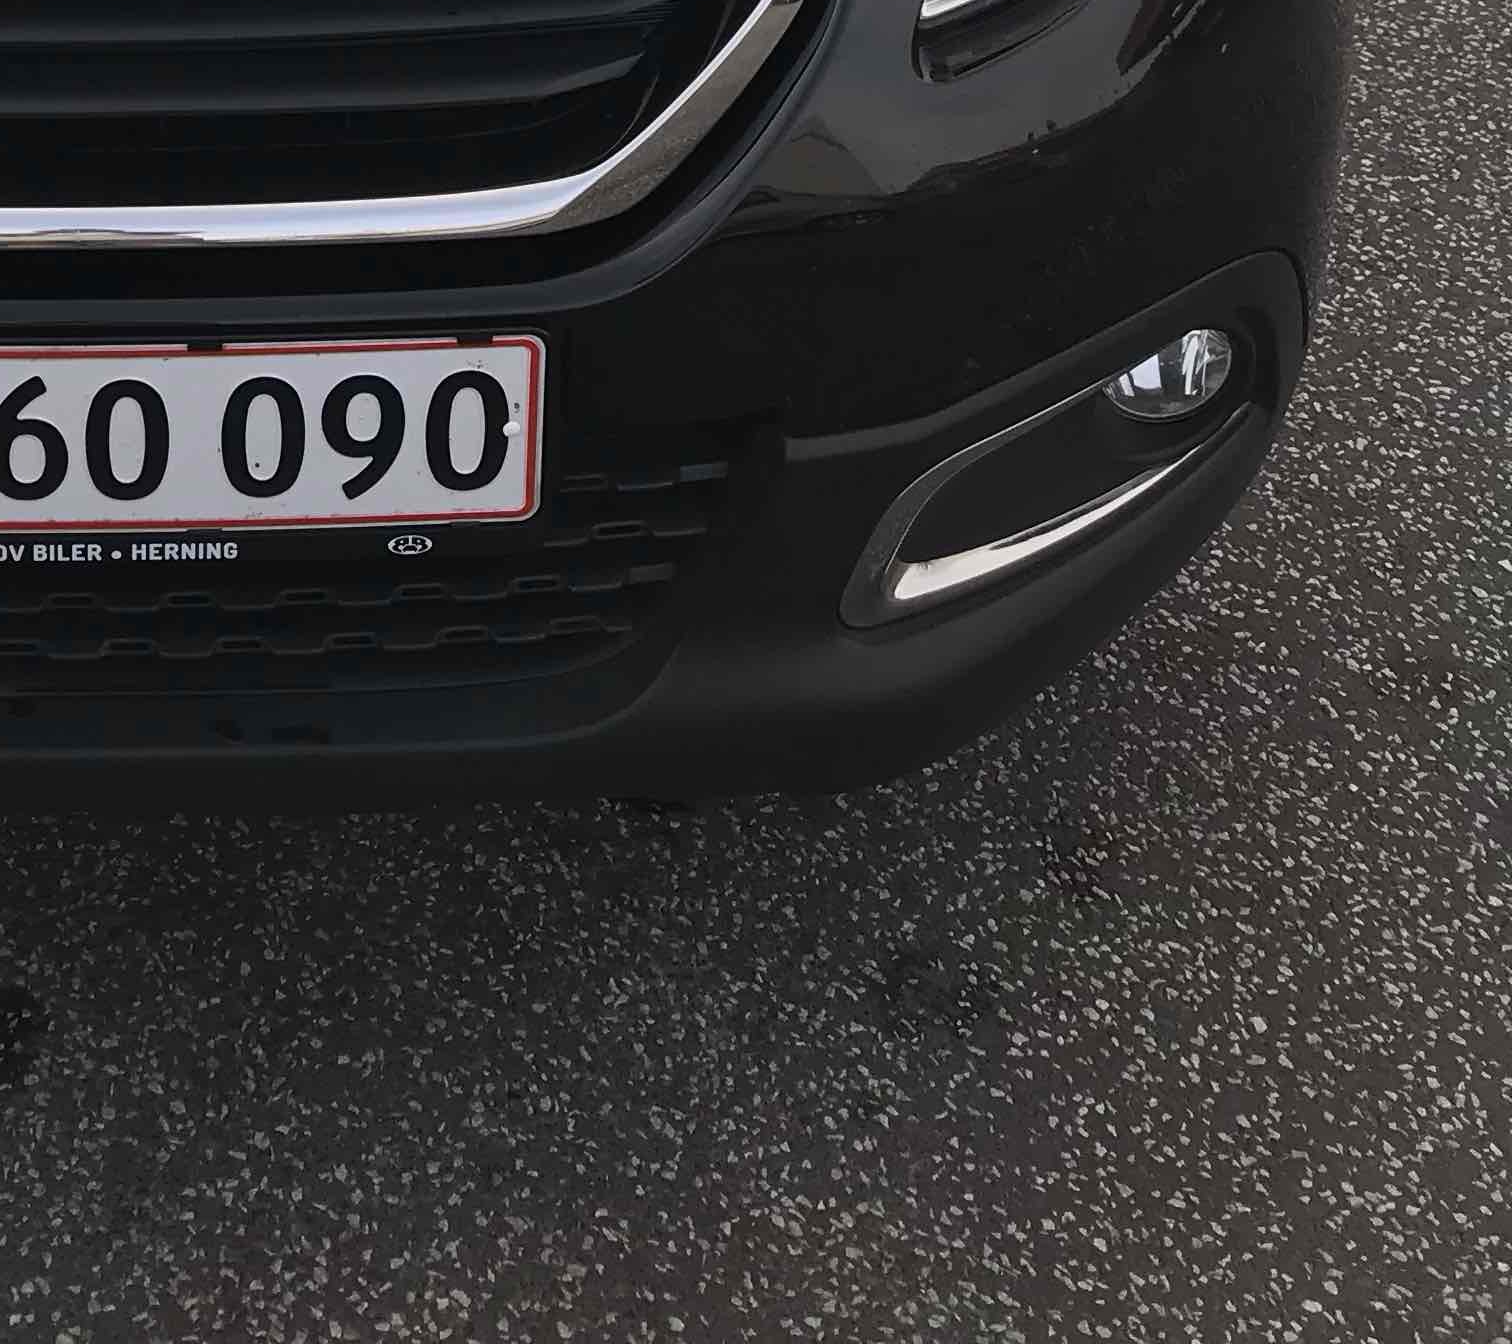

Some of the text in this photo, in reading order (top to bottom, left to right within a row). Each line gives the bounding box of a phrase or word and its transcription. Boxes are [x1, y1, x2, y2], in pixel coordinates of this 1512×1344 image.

[221, 369, 511, 501] 090
[33, 543, 103, 562] BILER
[131, 542, 239, 561] HERNING
